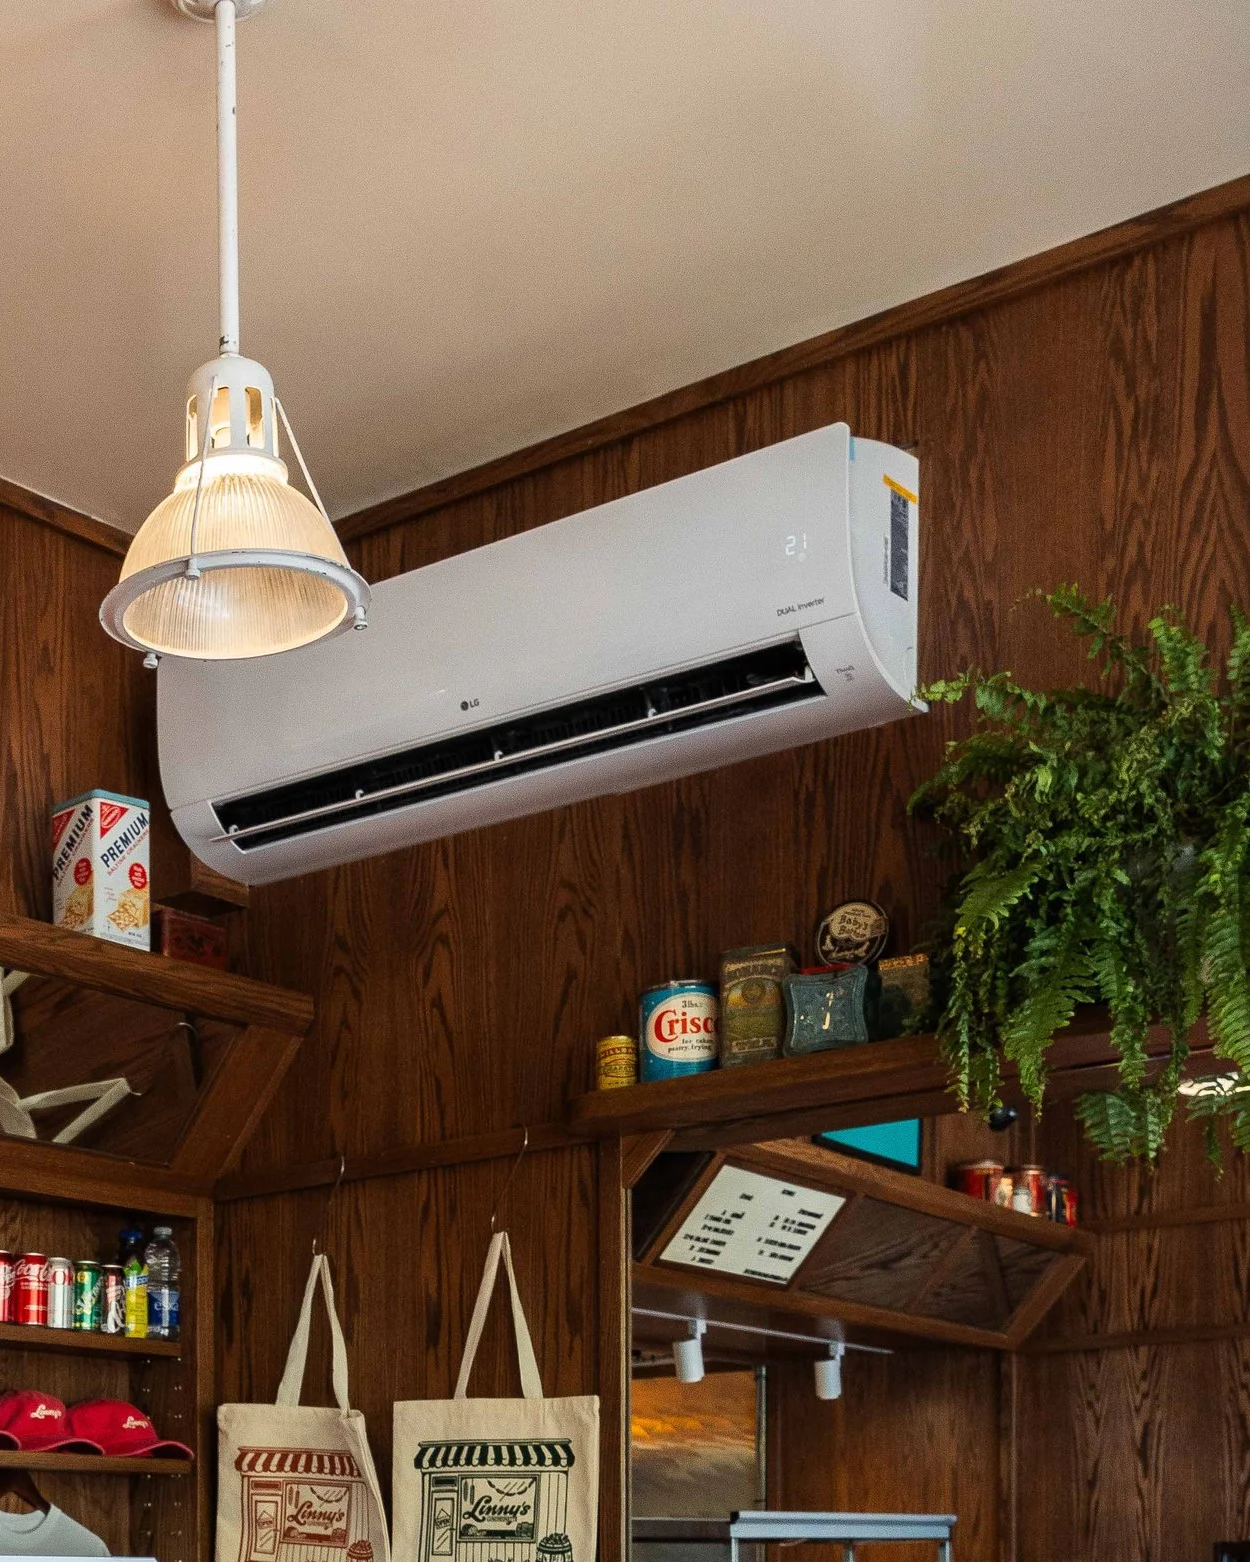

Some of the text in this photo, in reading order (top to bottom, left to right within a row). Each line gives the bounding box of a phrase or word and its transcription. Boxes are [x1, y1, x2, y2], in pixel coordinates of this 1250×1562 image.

[785, 533, 807, 556] 21
[776, 605, 796, 617] DUAL
[52, 804, 94, 881] PREMIUM
[100, 812, 150, 868] PREMIUM
[653, 1008, 719, 1044] Crisc
[287, 1500, 345, 1530] Linny's
[462, 1495, 531, 1525] Linny's
